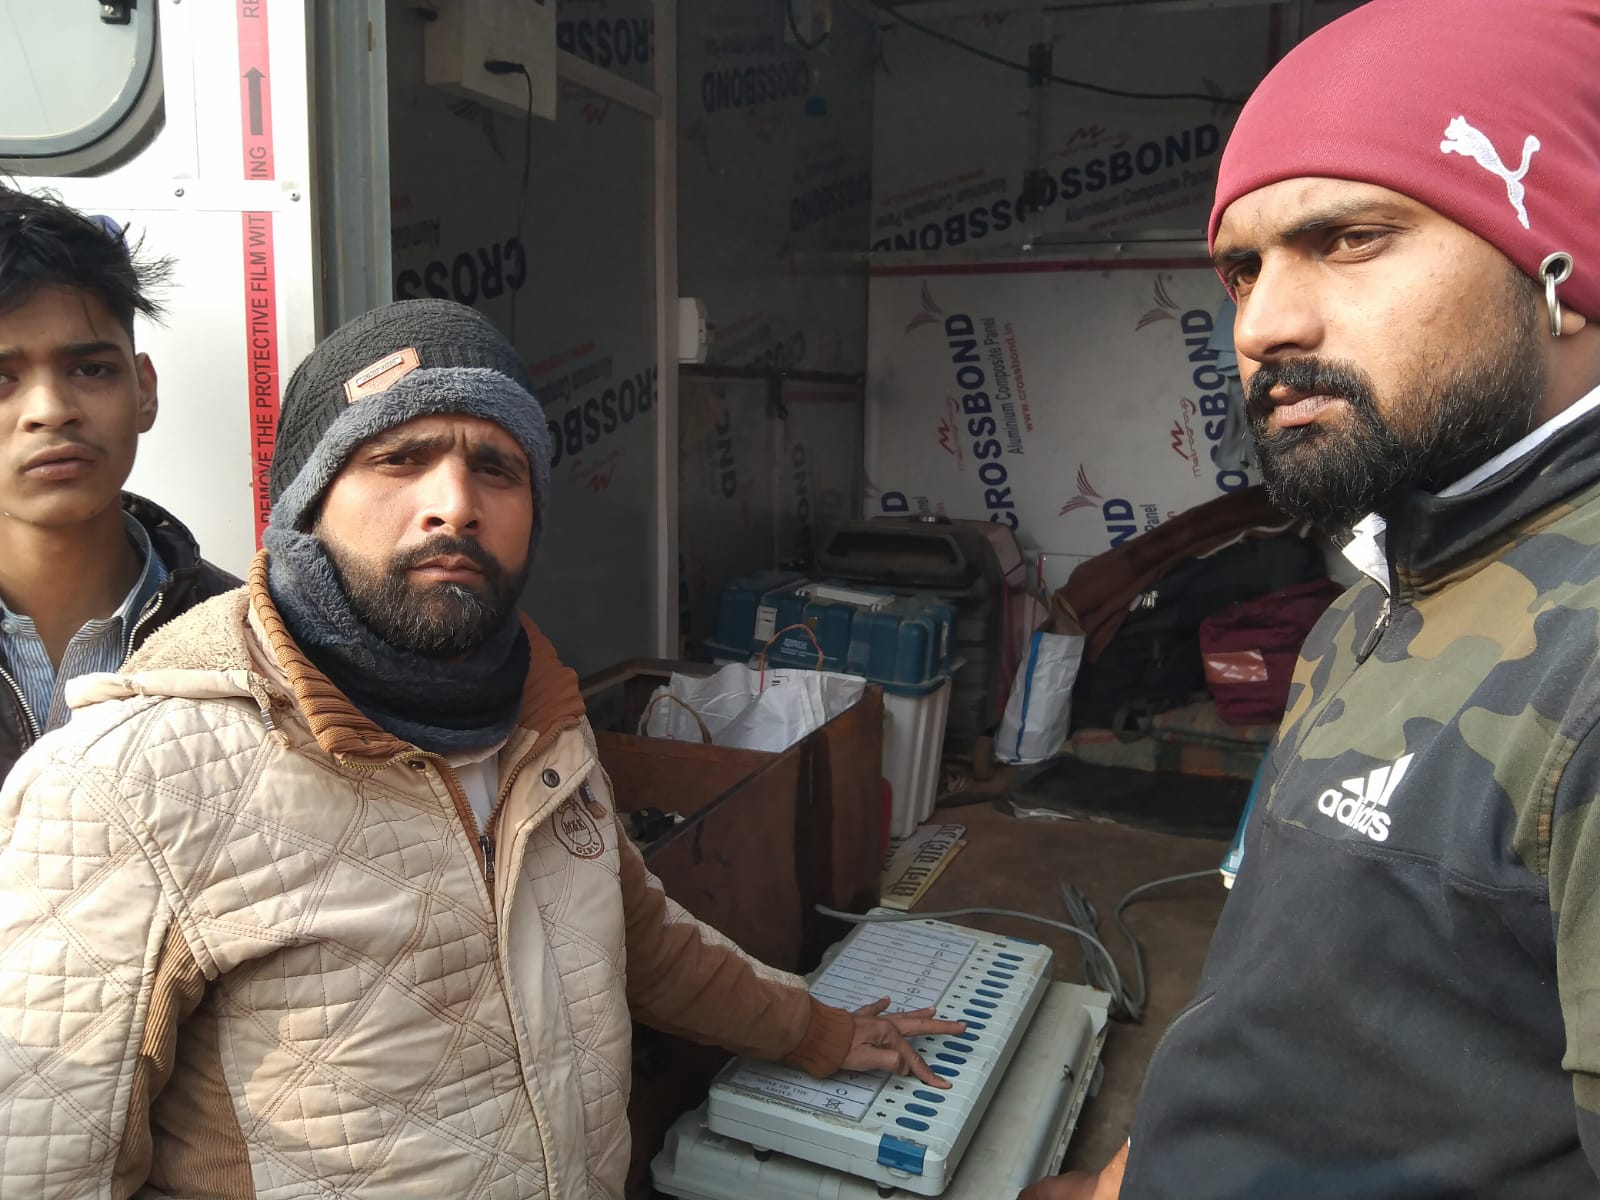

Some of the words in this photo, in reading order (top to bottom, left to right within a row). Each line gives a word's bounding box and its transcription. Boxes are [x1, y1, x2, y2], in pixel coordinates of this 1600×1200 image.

[248, 211, 266, 247] WIT
[250, 251, 268, 292] FILM
[251, 298, 273, 408] PROTECTIVE
[988, 347, 1011, 401] Composite
[256, 414, 273, 445] THE
[548, 365, 658, 468] ROSSBO
[1002, 401, 1024, 455] Aluminium
